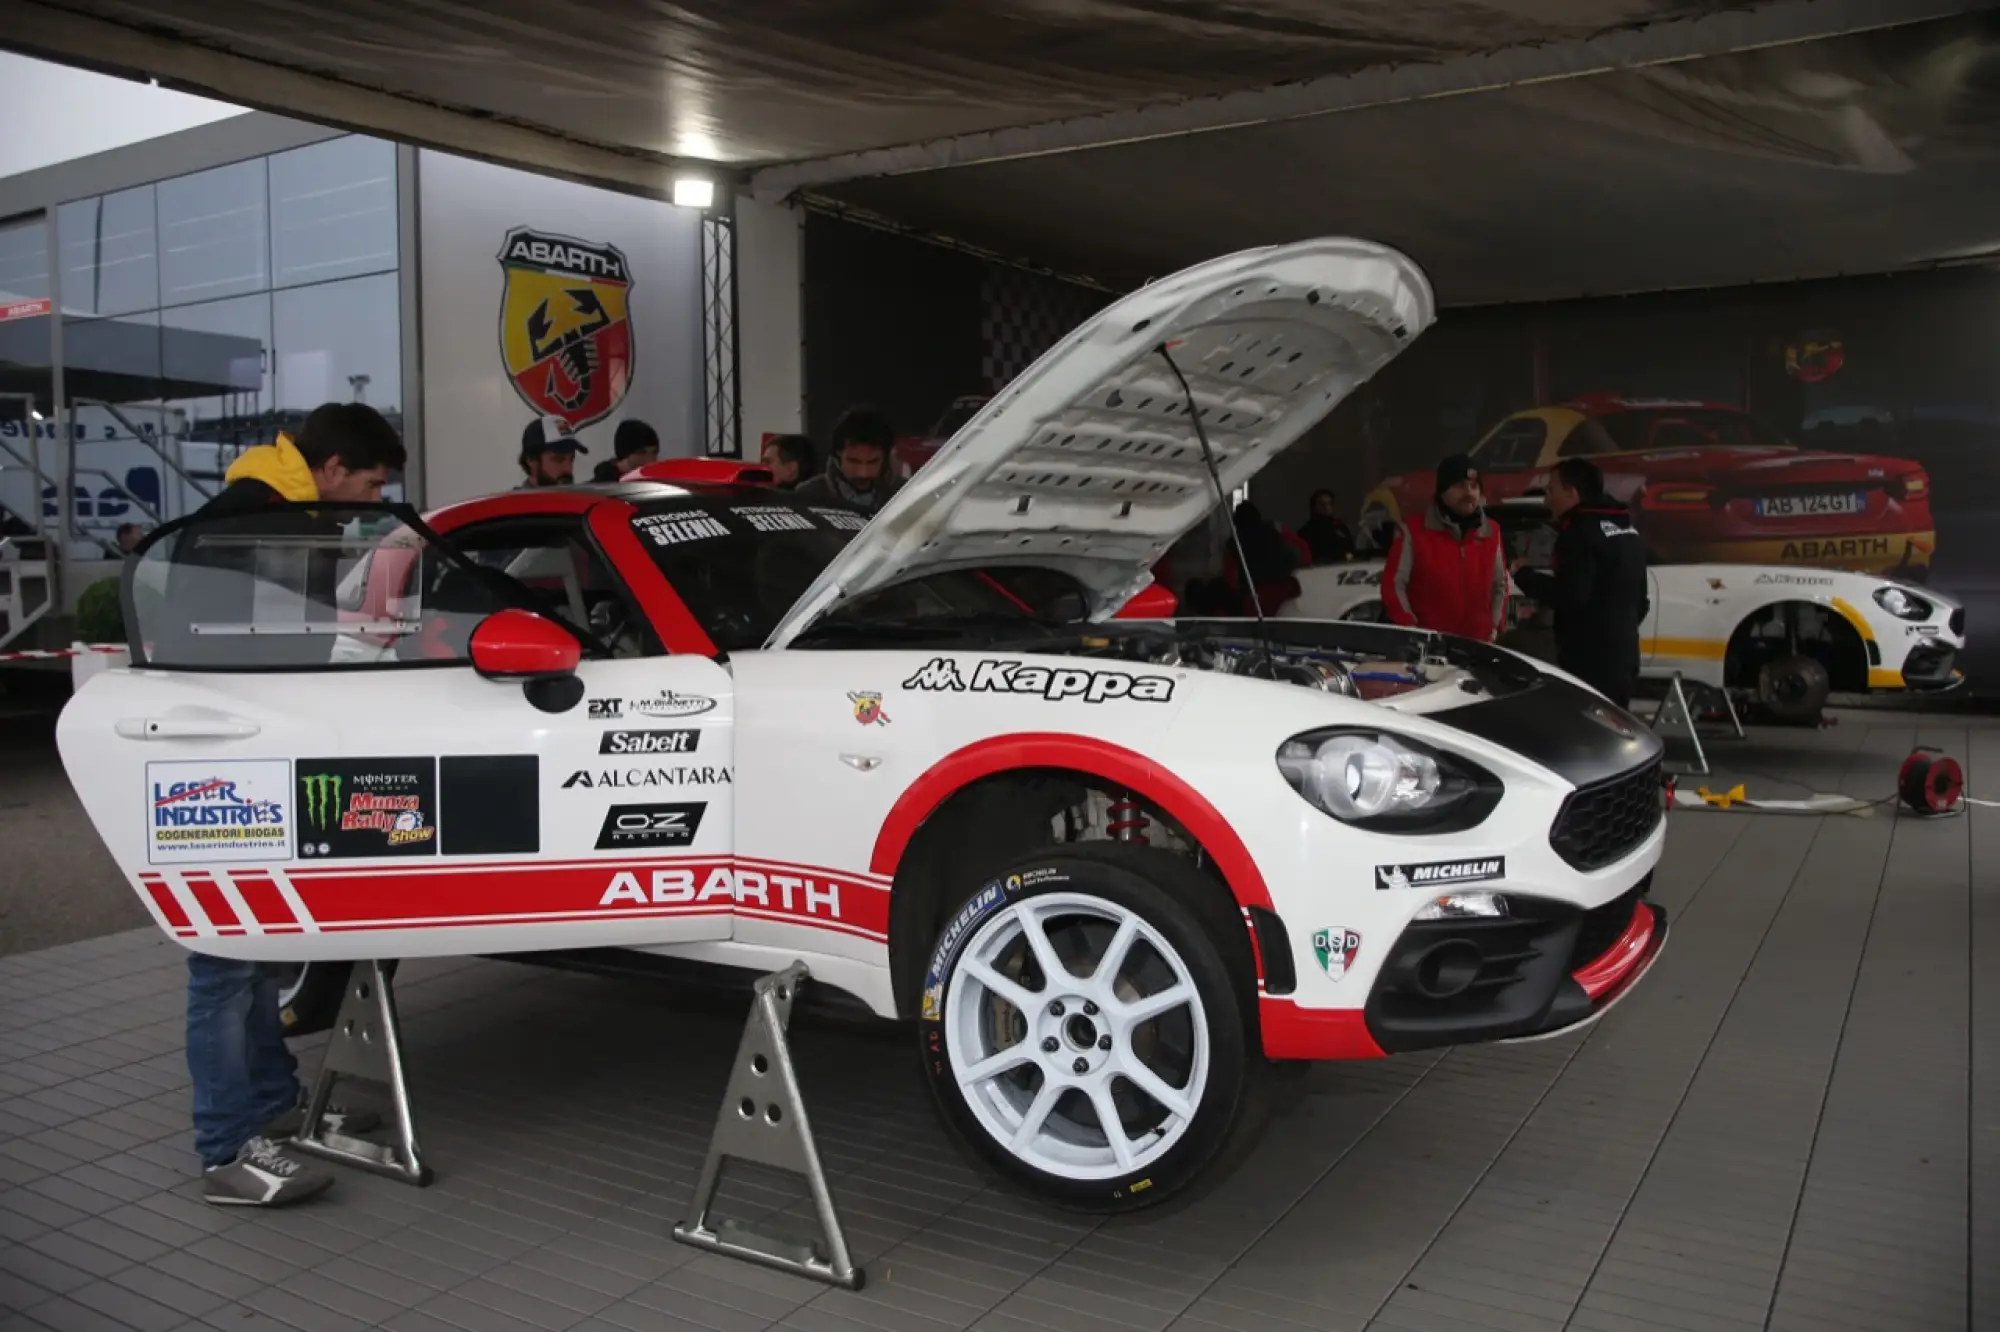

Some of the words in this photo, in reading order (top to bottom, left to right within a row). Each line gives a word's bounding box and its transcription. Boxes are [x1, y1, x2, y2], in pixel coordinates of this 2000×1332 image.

[511, 241, 620, 276] ABARTH
[1767, 497, 1793, 514] AB
[648, 517, 731, 545] SELENIA
[1781, 537, 1888, 561] ABARTH
[970, 660, 1175, 703] Kappa
[610, 731, 690, 753] Sabelt
[598, 766, 732, 787] ALCANTARA
[342, 811, 397, 832] Rally
[156, 828, 241, 840] COGENERATORI
[244, 826, 285, 838] BIOGAS
[157, 839, 286, 851] www.laserindustries.it
[1414, 861, 1500, 880] MICHELIN
[598, 867, 840, 918] ABARTH
[932, 885, 997, 978] MICHELIN
